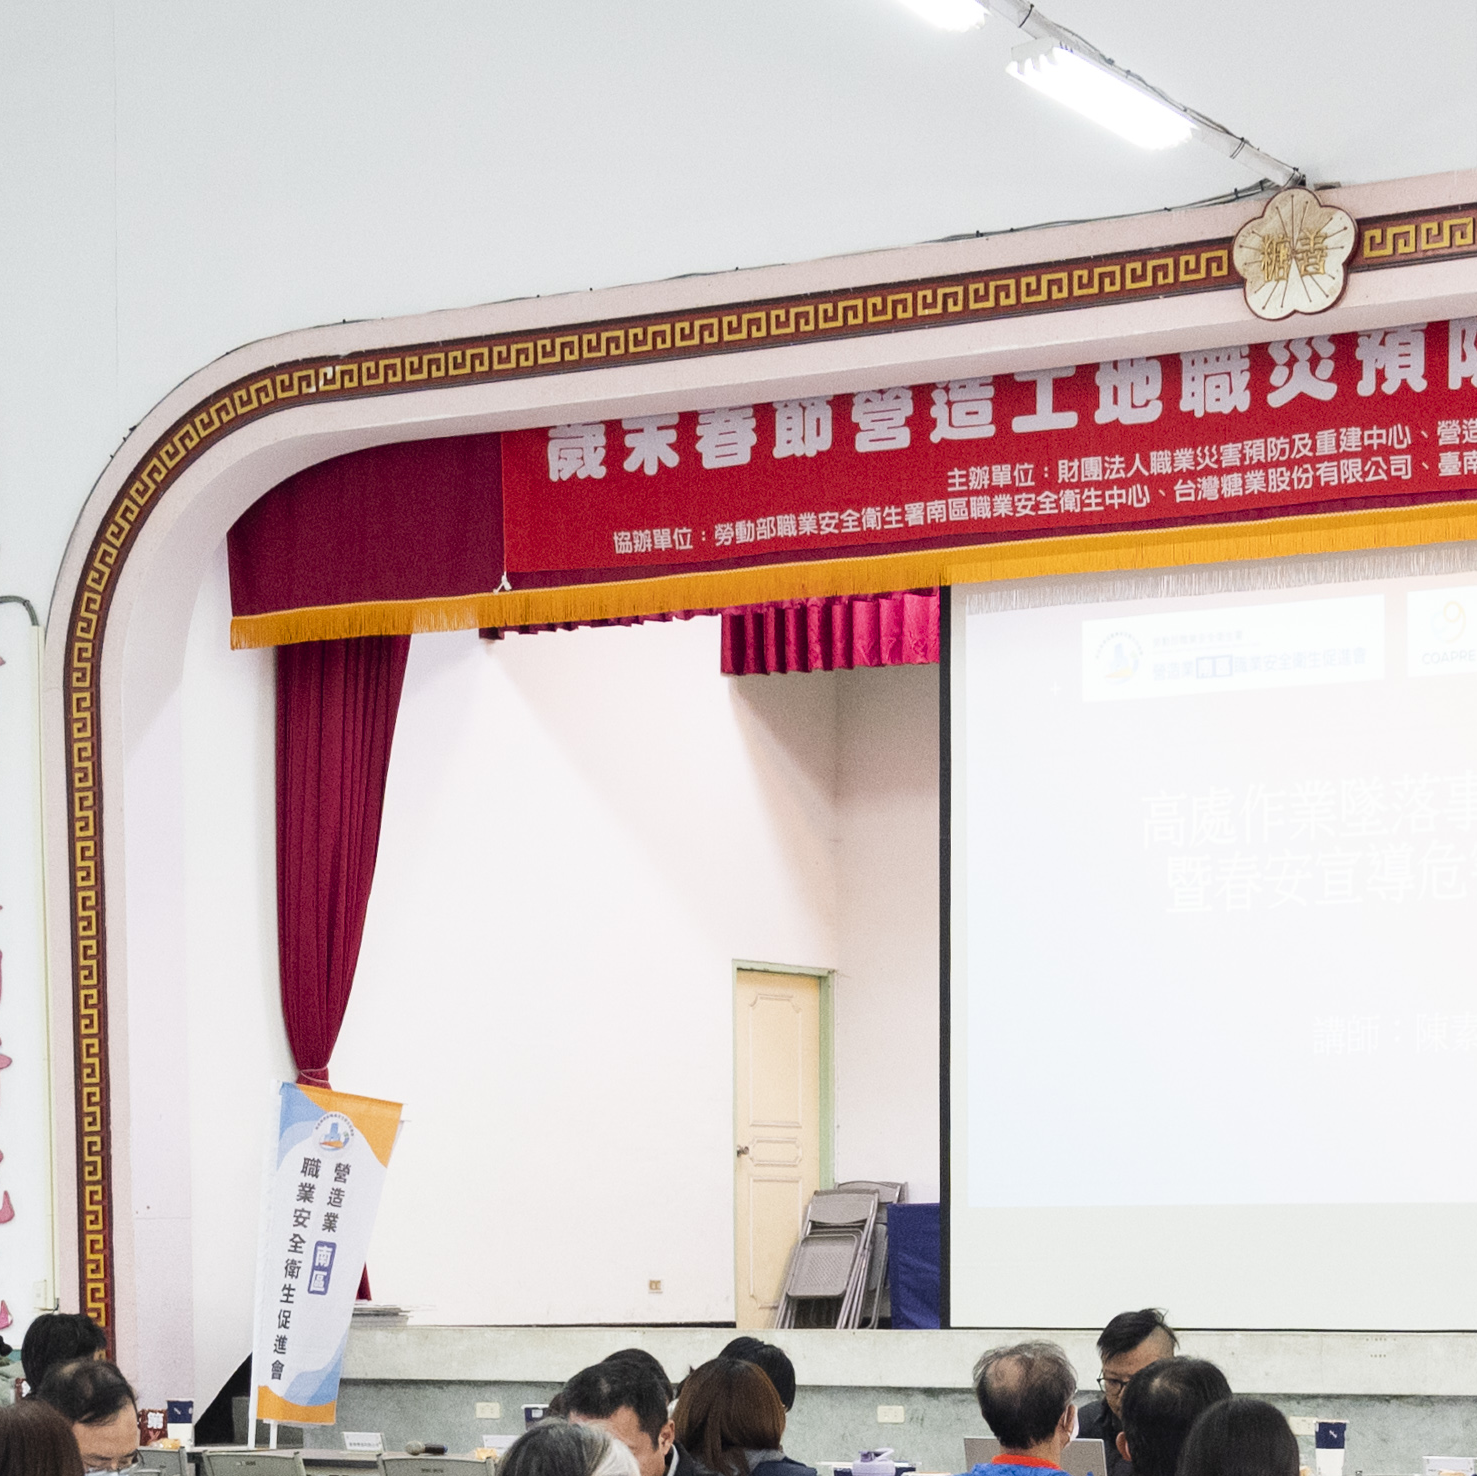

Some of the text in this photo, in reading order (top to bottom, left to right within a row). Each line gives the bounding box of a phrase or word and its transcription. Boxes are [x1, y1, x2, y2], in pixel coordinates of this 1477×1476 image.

[1421, 648, 1477, 666] COAPRE
[271, 1156, 322, 1382] 職業安全衛生促進會
